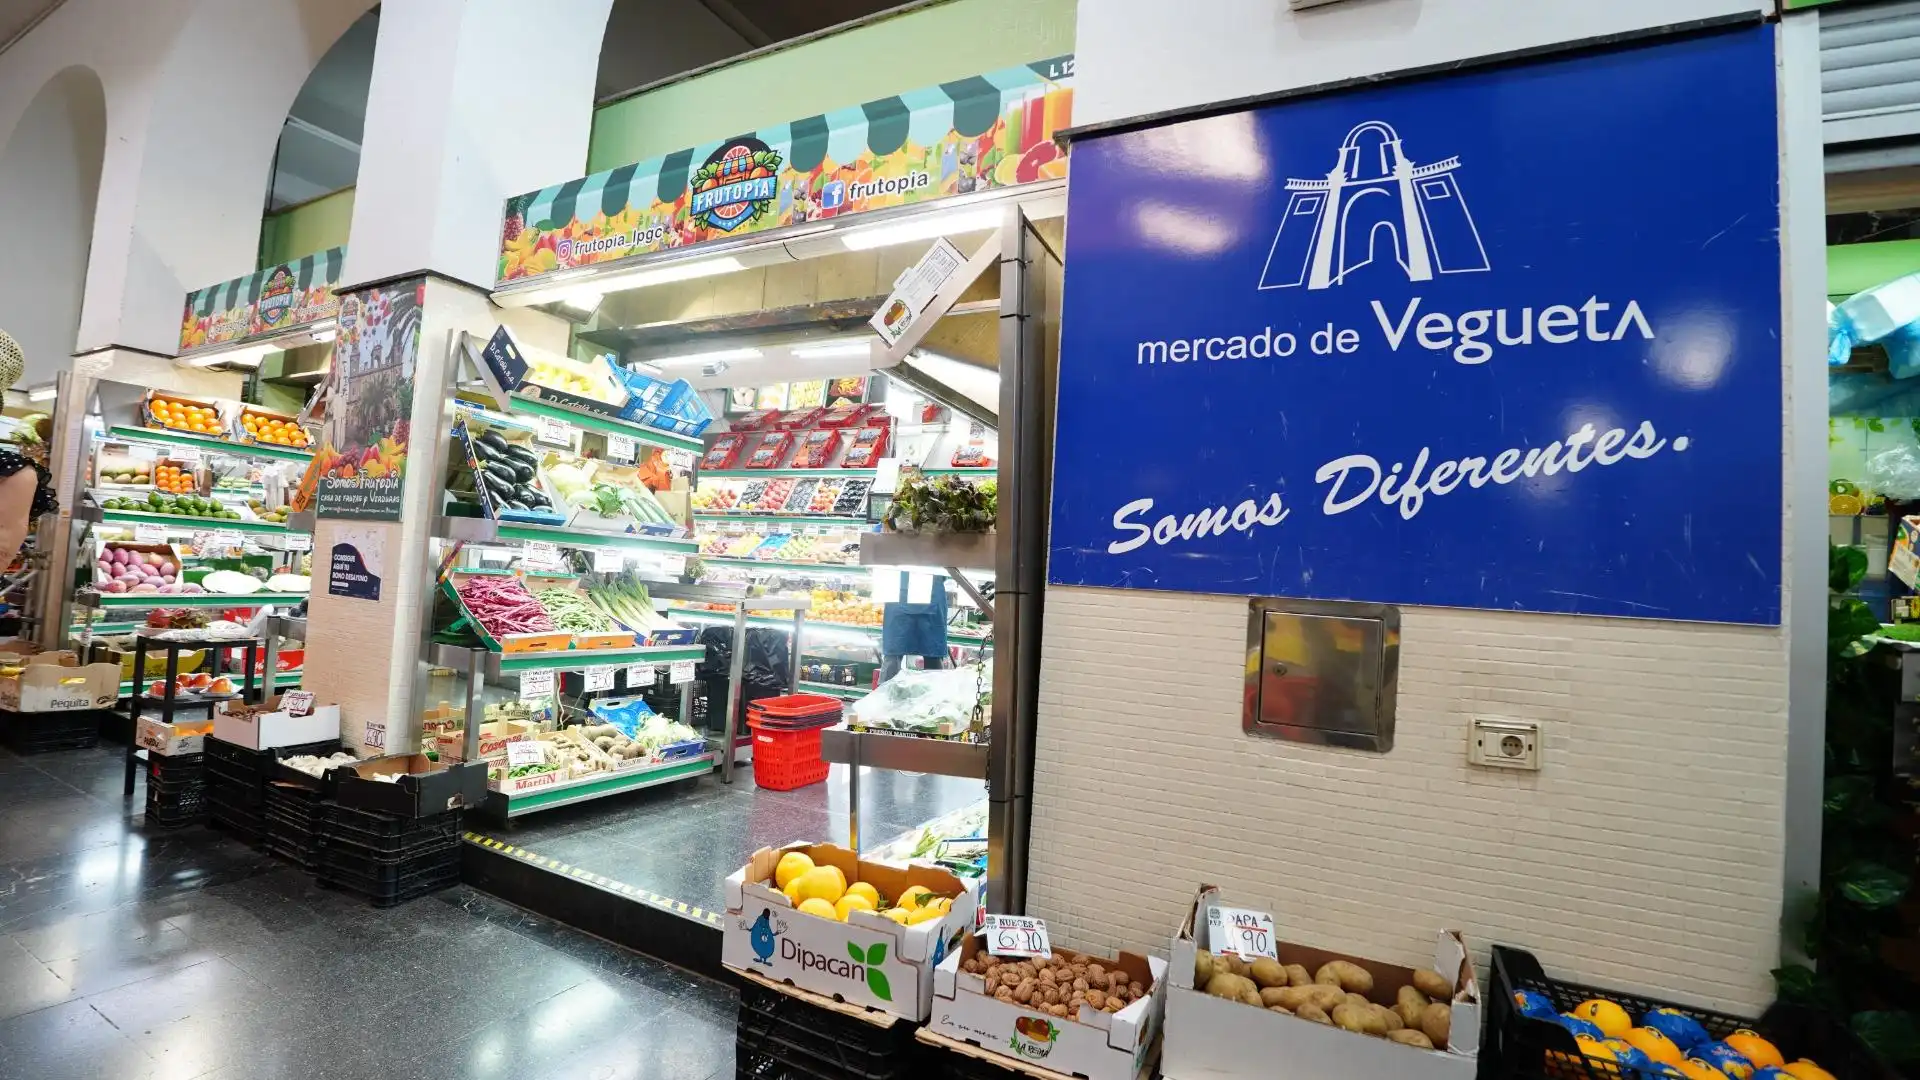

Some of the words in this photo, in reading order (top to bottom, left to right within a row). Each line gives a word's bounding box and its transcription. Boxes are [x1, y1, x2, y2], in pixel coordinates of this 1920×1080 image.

[1050, 64, 1059, 78] L
[849, 171, 928, 199] frutopia
[574, 226, 663, 256] frutopia_lpgc
[1137, 326, 1297, 365] mercado
[1310, 322, 1360, 355] de
[1107, 491, 1290, 555] Somos
[1315, 419, 1688, 521] Diferentes.
[998, 918, 1034, 929] NUECES
[780, 937, 866, 982] Dipacan
